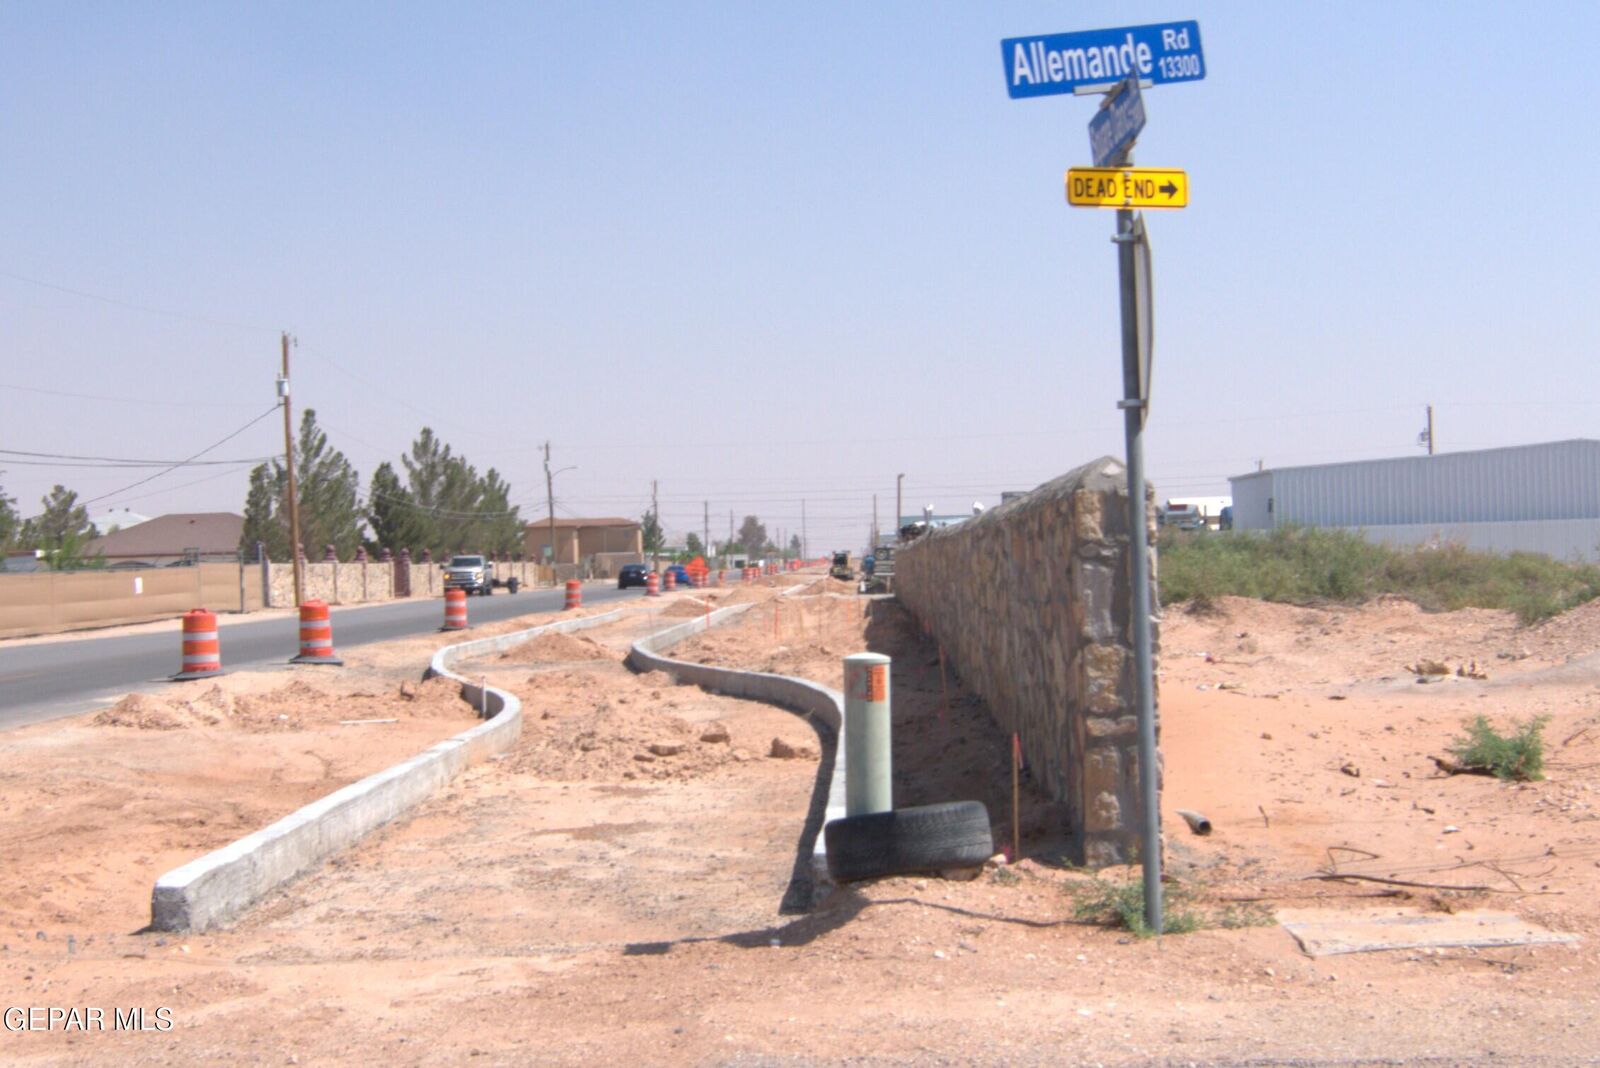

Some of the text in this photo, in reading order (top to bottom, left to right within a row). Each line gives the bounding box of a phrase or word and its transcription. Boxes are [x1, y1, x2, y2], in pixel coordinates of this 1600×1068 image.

[1161, 28, 1190, 51] Rd
[1013, 33, 1153, 86] Allemande
[1158, 54, 1200, 79] 13300
[1073, 177, 1155, 199] DEAD END
